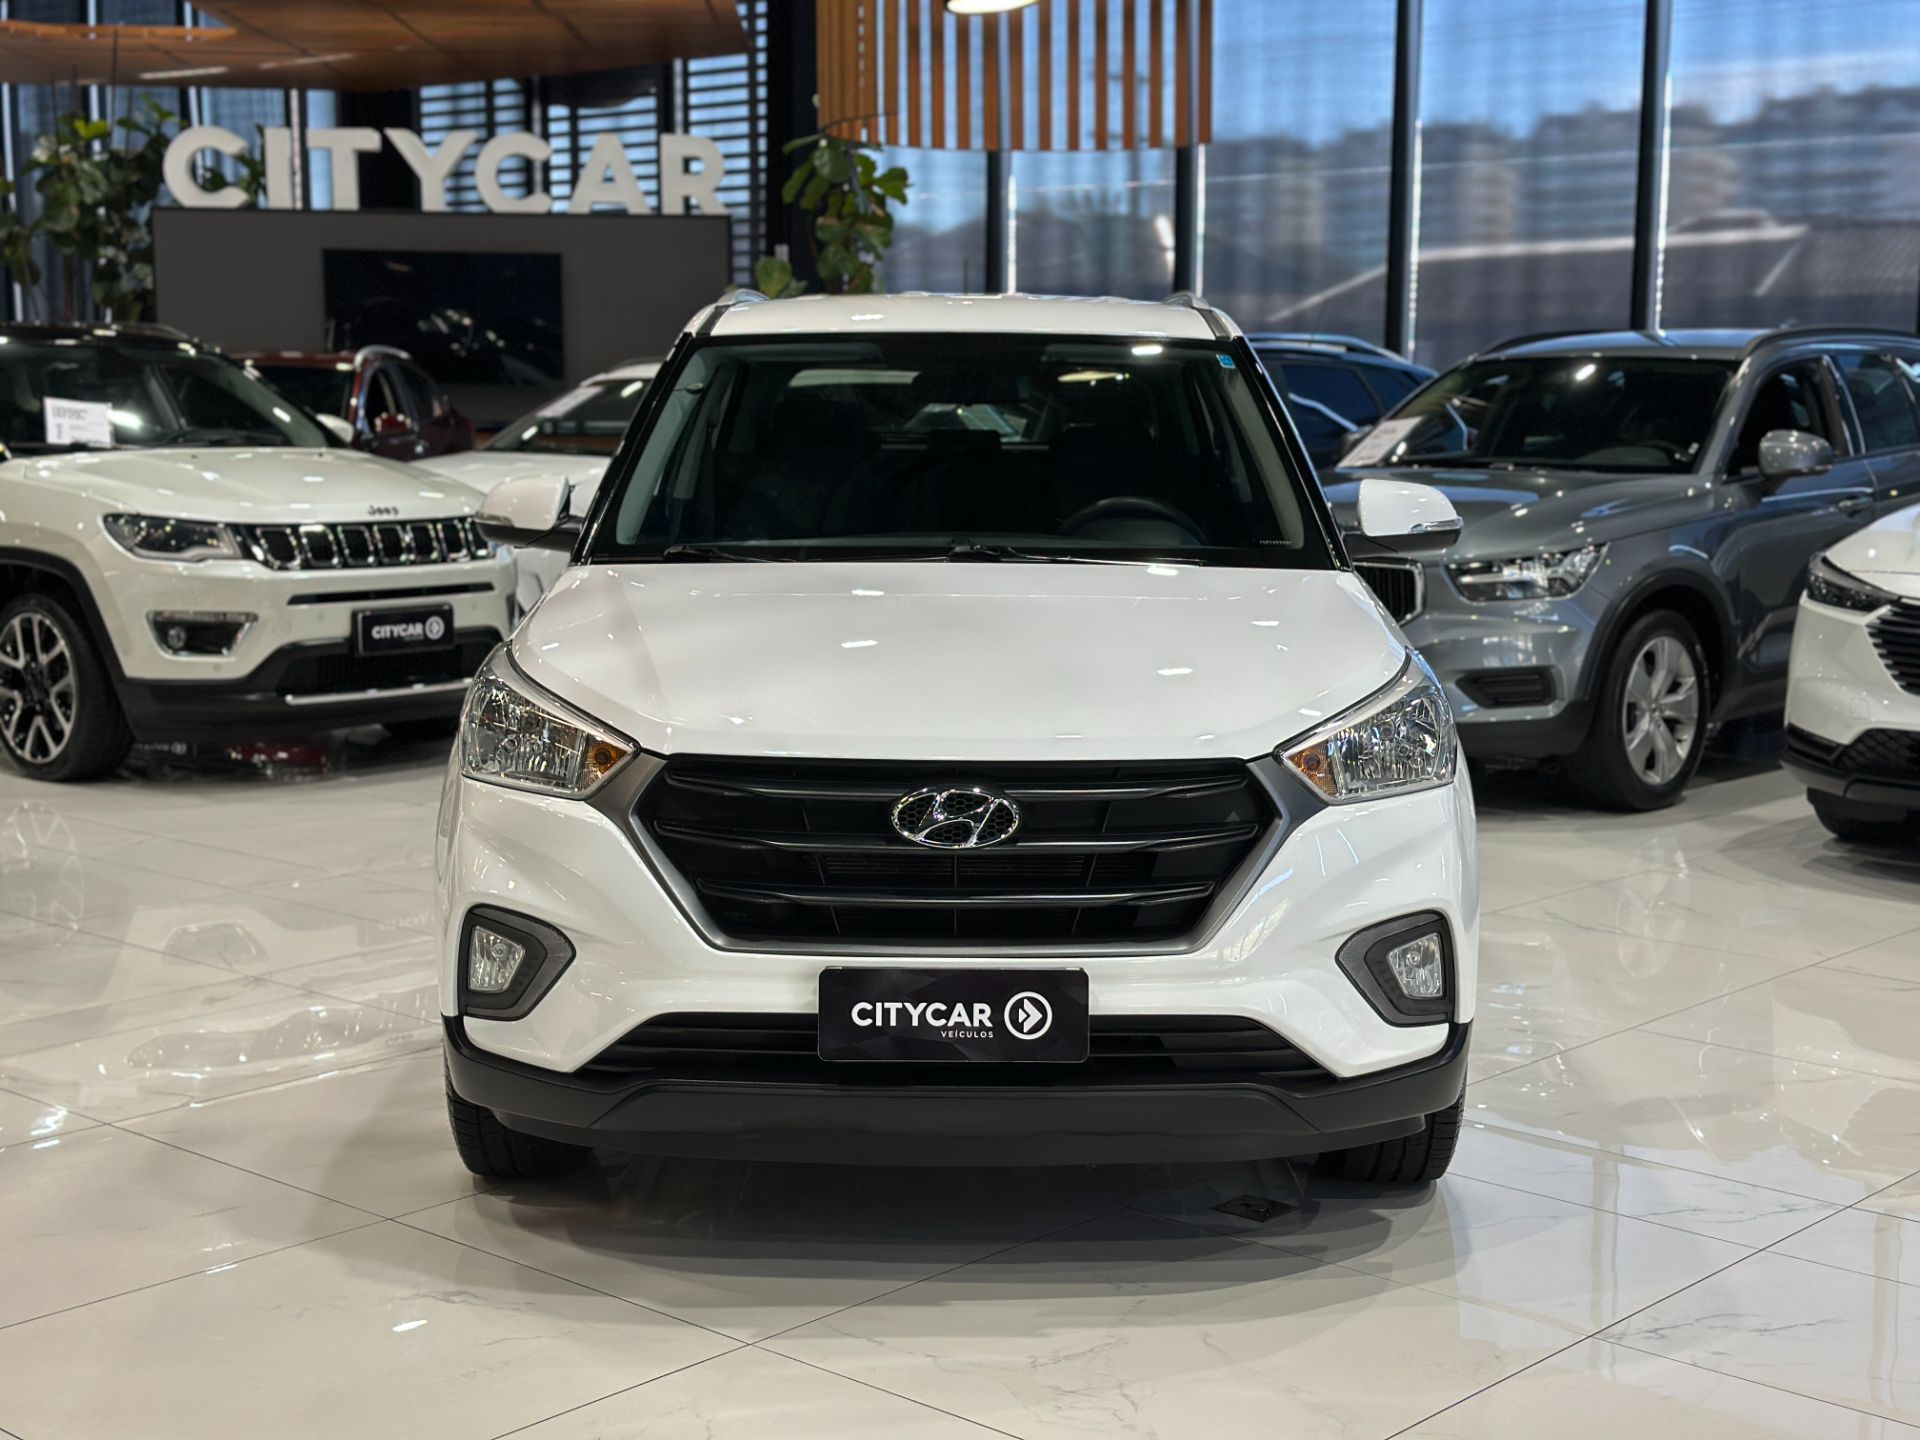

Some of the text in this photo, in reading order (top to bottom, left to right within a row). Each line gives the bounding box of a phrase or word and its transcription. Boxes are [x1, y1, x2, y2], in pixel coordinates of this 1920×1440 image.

[162, 125, 729, 215] CITYCAR
[371, 621, 425, 640] CITYCAR
[851, 1001, 993, 1028] CITYCAR
[940, 1028, 994, 1039] VEÍCULOS
